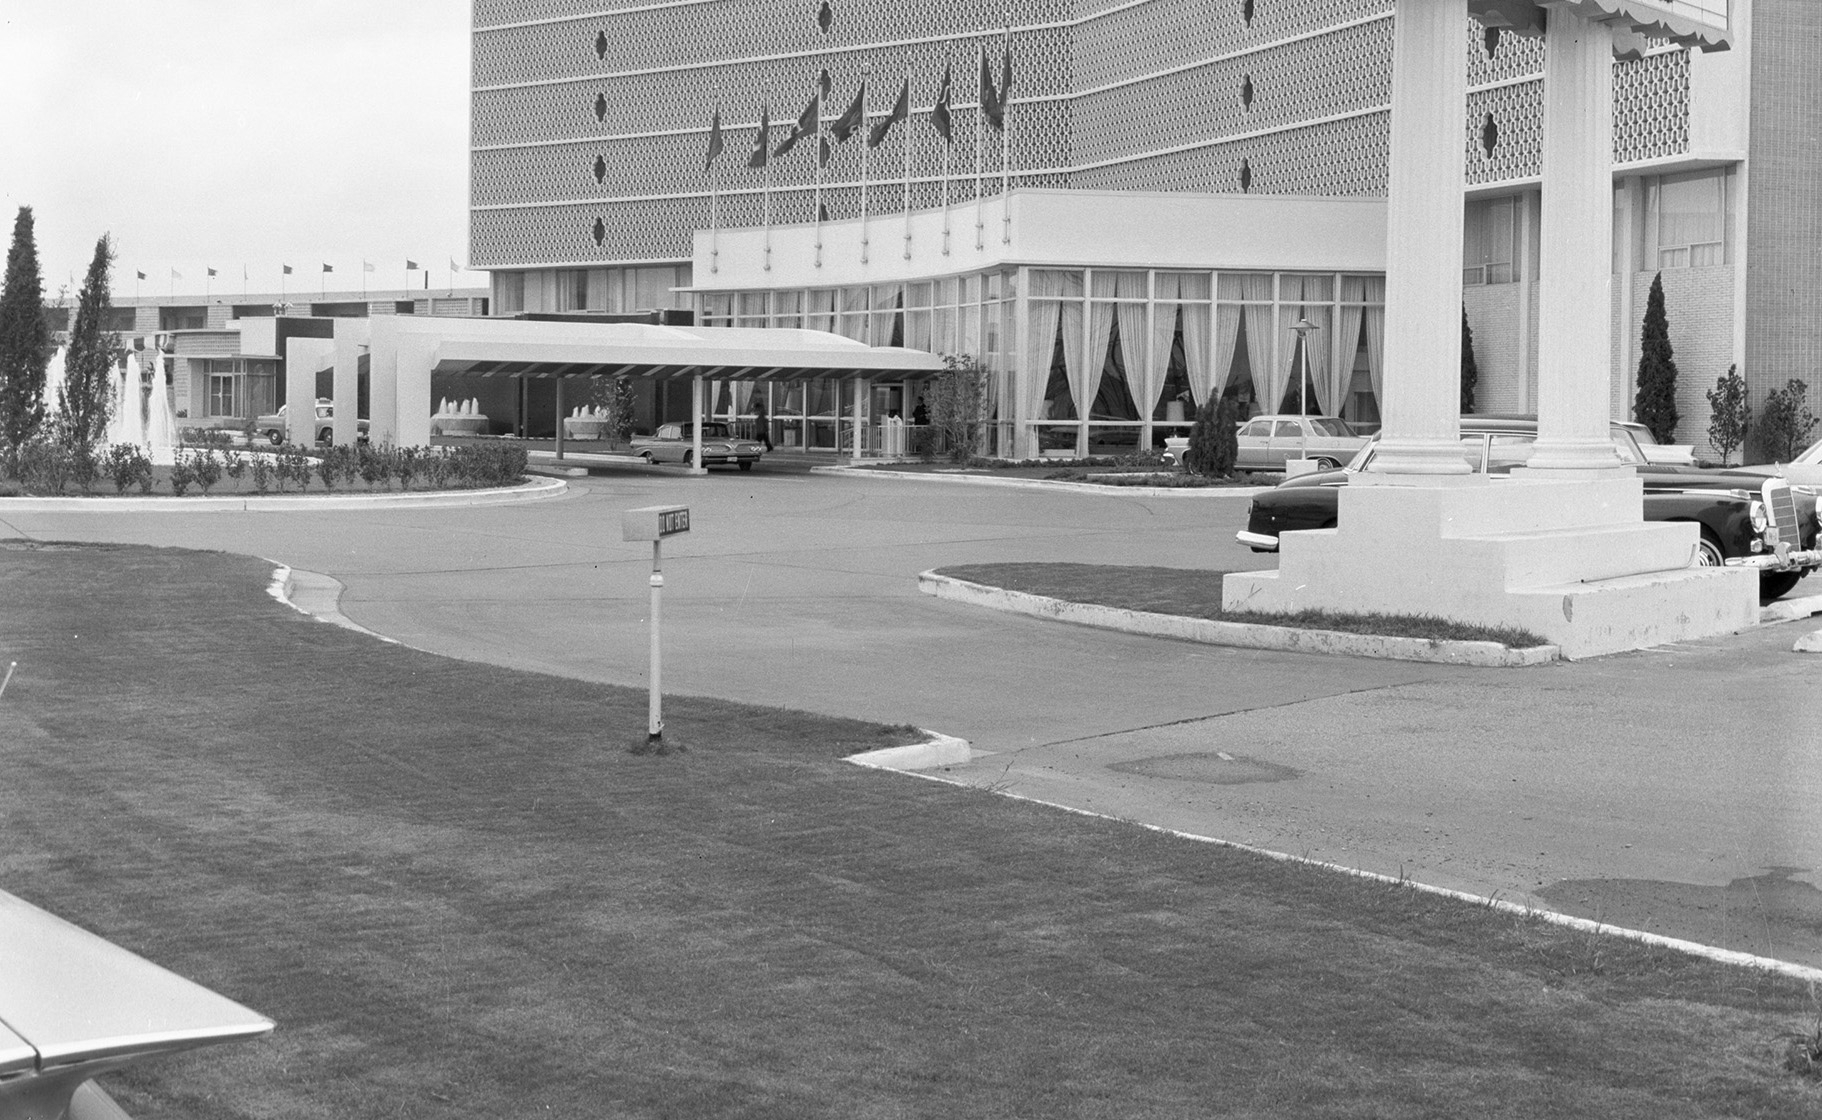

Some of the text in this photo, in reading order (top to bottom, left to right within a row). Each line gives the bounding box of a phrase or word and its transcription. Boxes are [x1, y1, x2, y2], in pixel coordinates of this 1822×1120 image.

[659, 511, 688, 533] DO NOT ENTER
